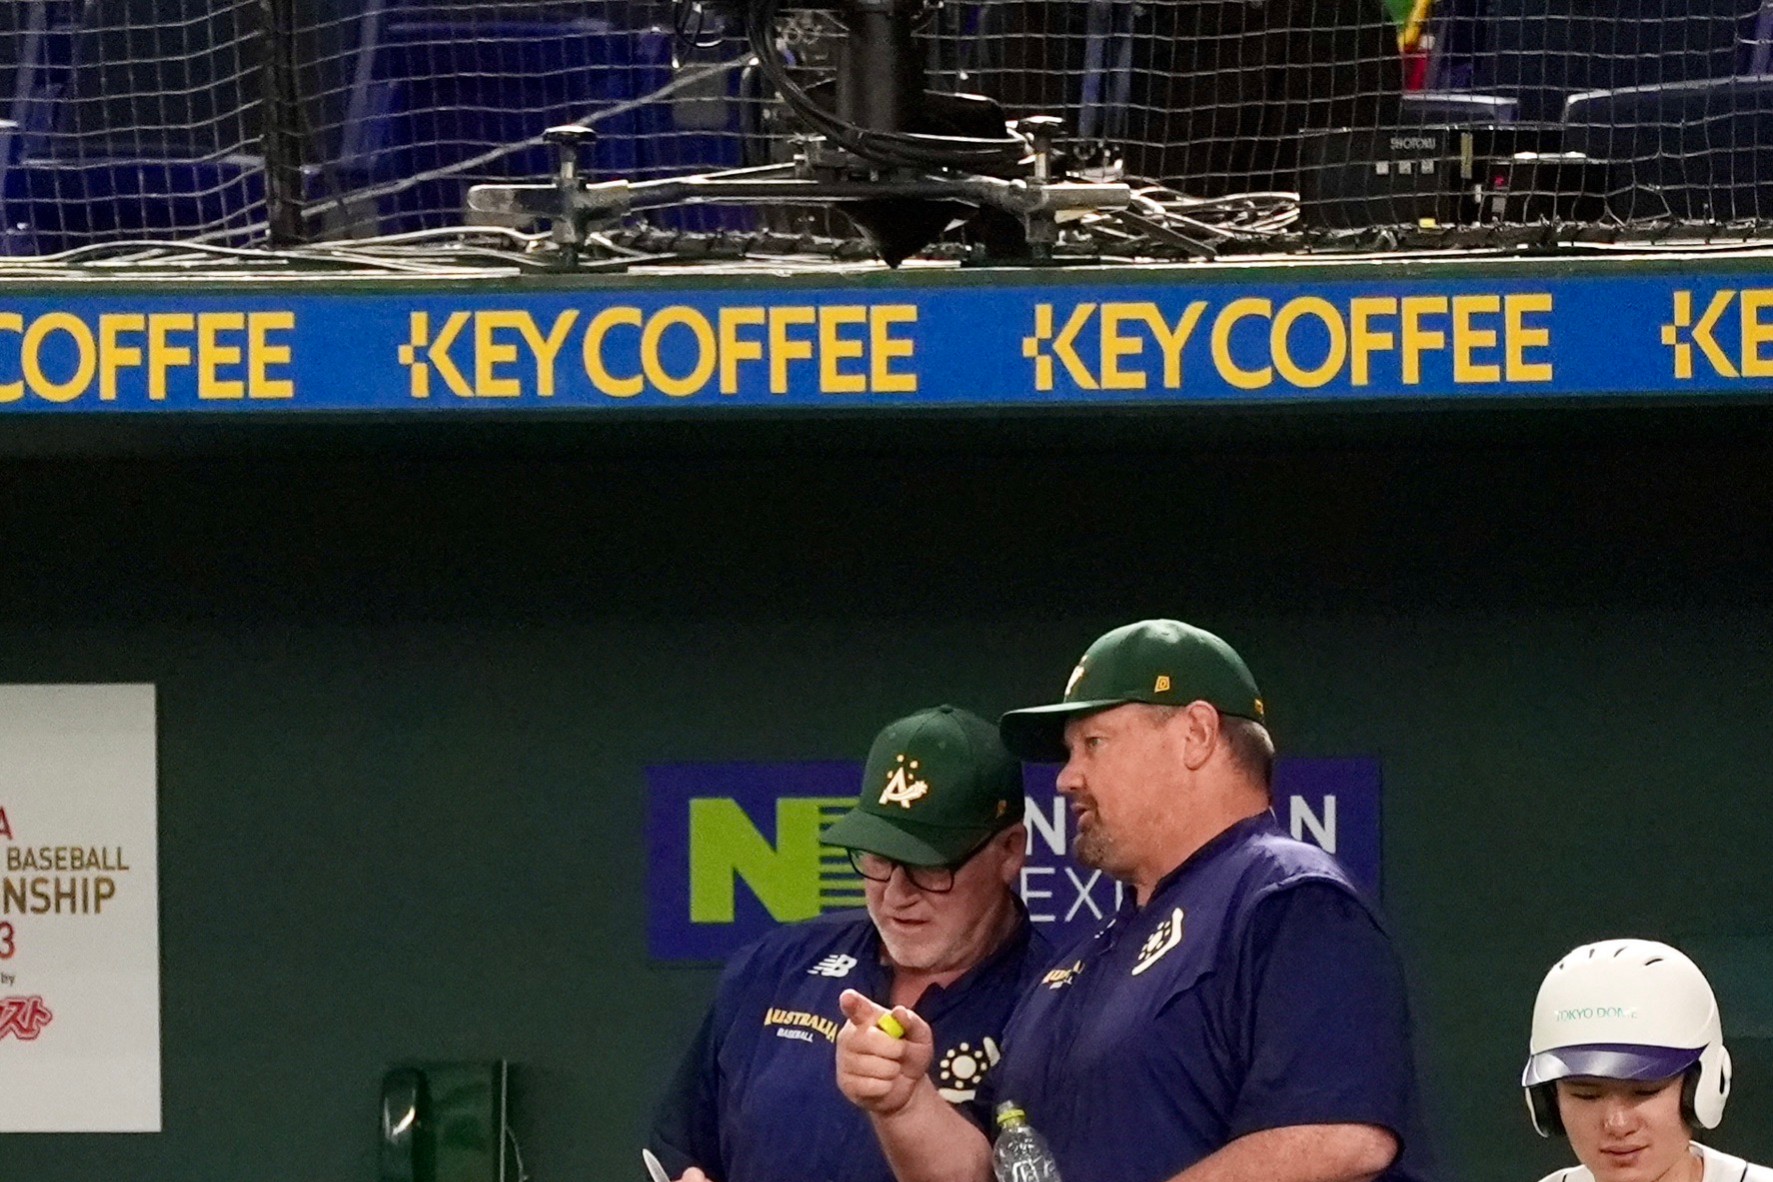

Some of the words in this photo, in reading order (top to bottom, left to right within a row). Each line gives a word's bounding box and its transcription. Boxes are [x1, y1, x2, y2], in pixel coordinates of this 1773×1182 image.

[7, 846, 129, 871] BASEBALL
[3, 877, 115, 915] NSHIP
[764, 1007, 838, 1043] AUSTRALIA
